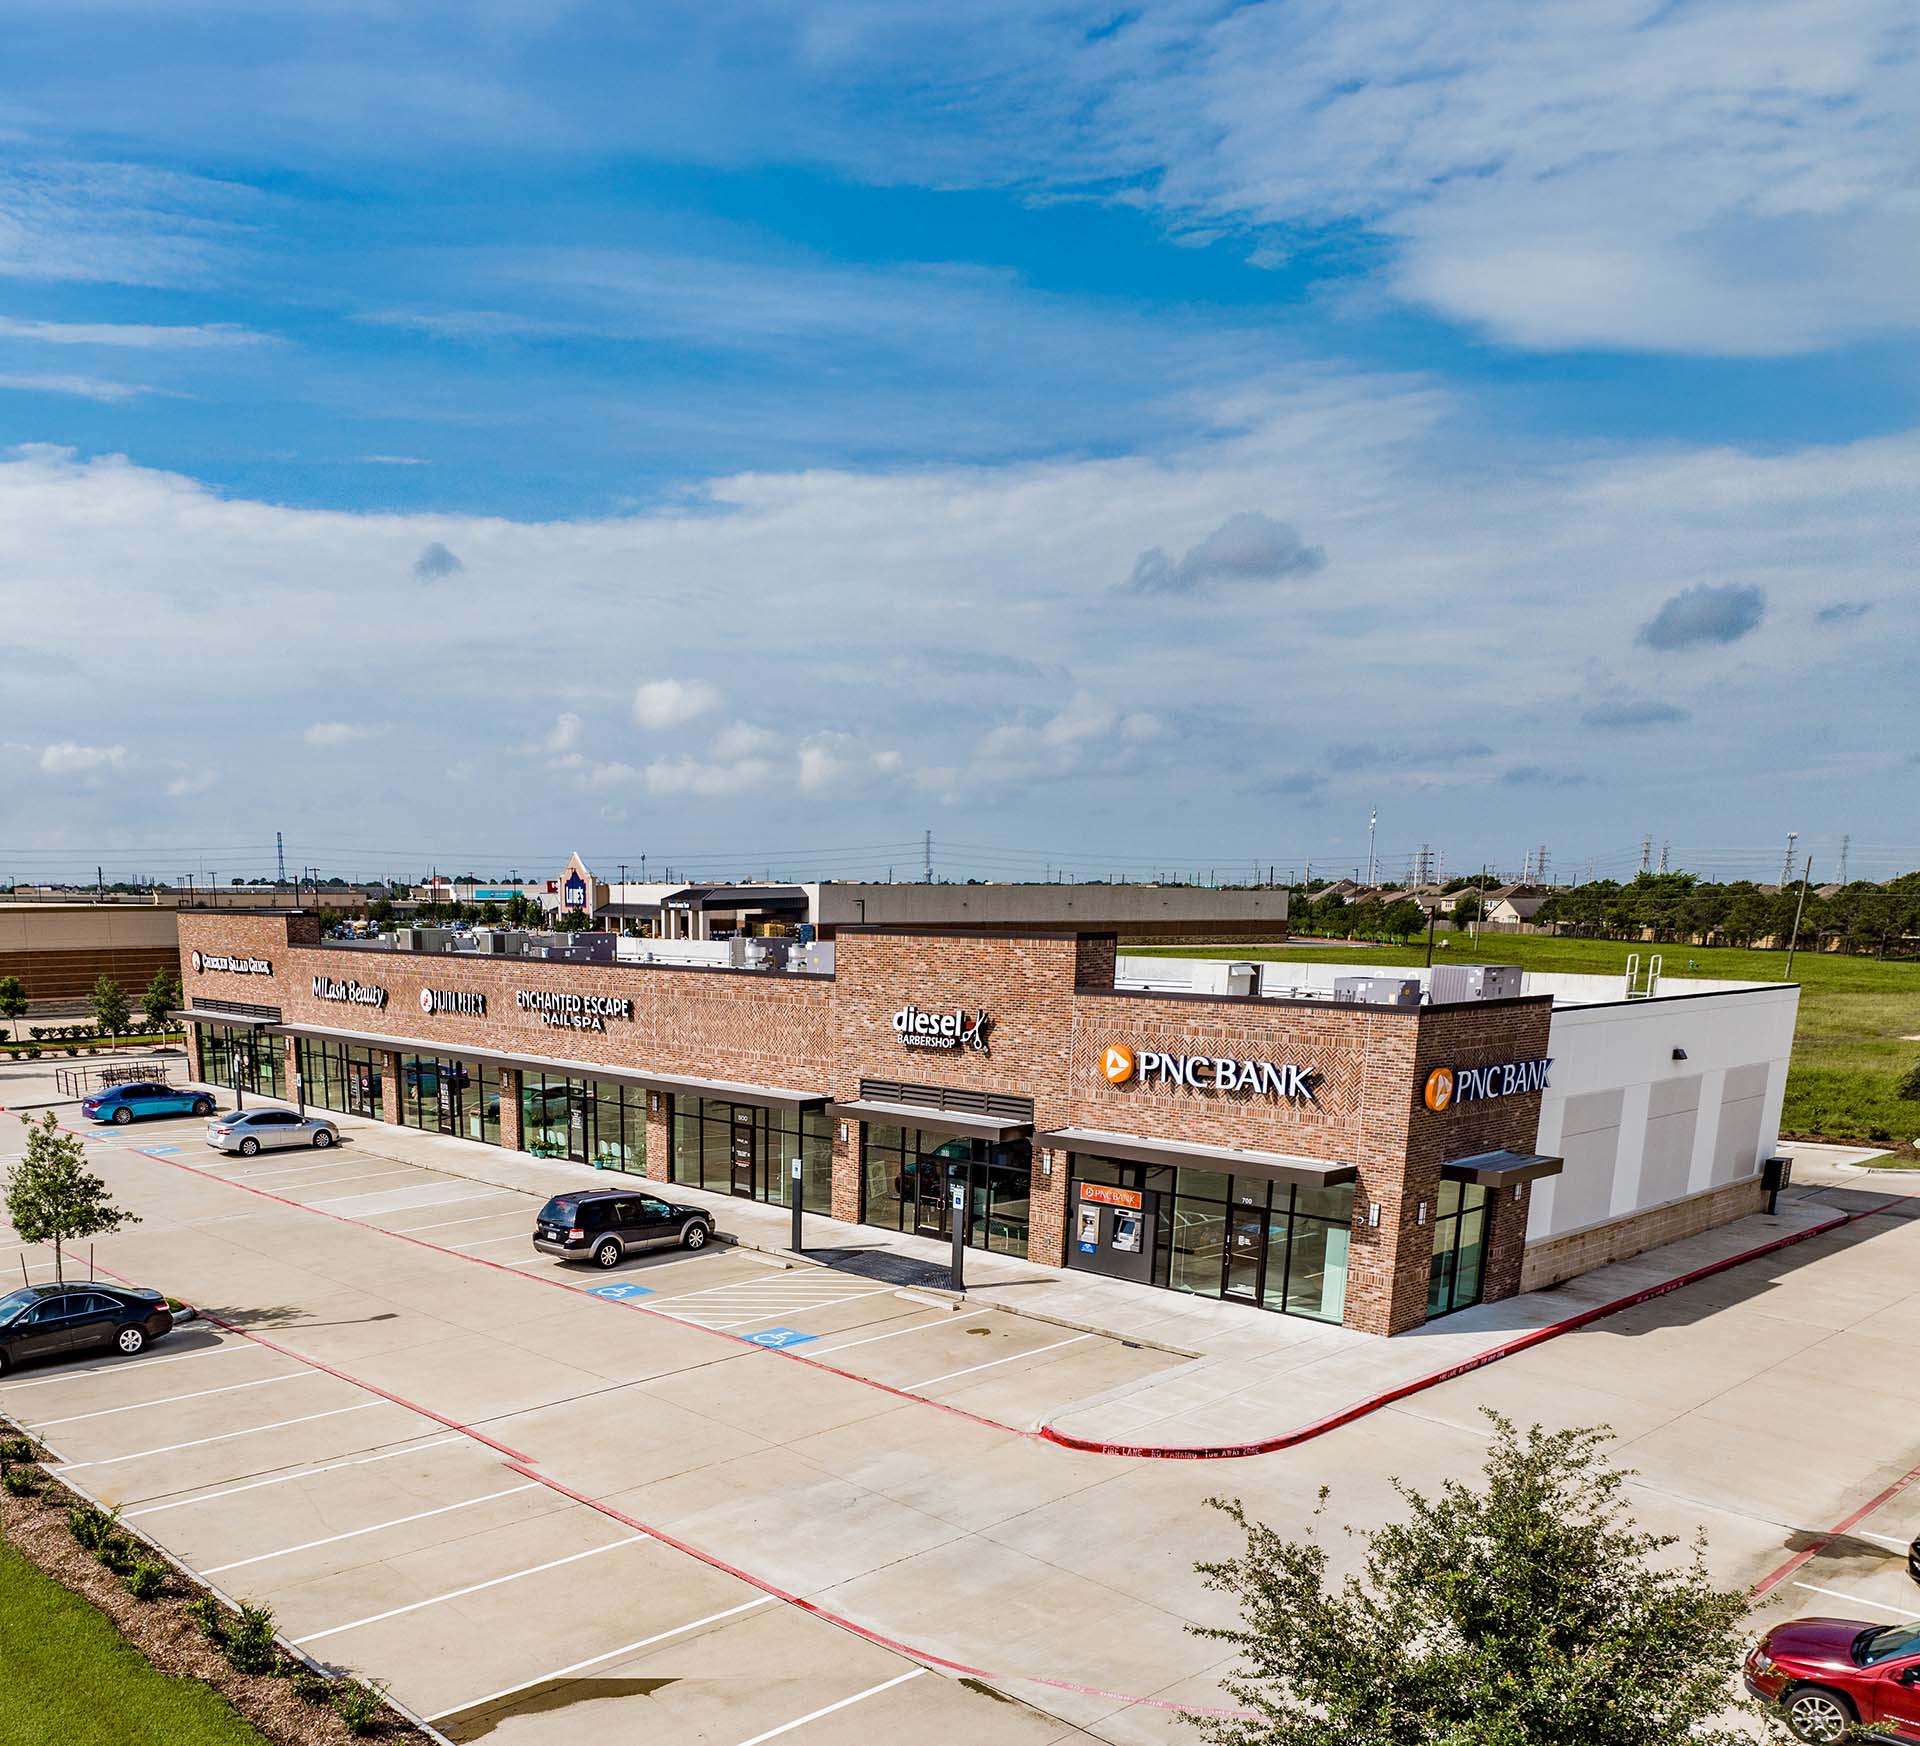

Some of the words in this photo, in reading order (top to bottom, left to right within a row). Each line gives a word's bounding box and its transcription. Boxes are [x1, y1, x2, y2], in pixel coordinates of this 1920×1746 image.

[202, 954, 228, 970] CHICKEN
[228, 956, 249, 972] SALAD
[249, 957, 270, 974] CHICK
[348, 980, 384, 1009] Beauty
[433, 990, 456, 1011] FAJITA
[458, 991, 483, 1014] PETE'S
[516, 990, 581, 1012] ENCHANTED
[584, 995, 629, 1017] ESCAPE
[541, 1012, 570, 1026] NAIL
[574, 1016, 602, 1029] SPA
[892, 1006, 962, 1036] diesel
[897, 1034, 956, 1048] BARBERSHOP
[1137, 1051, 1209, 1088] PNC
[1213, 1058, 1314, 1099] BANK
[1455, 1066, 1501, 1103] PNC
[1502, 1059, 1554, 1095] BANK
[1095, 1189, 1112, 1199] PNC
[1113, 1191, 1136, 1204] BANK
[1241, 1197, 1253, 1205] 700
[1102, 1445, 1120, 1455] FIRE
[1122, 1447, 1143, 1457] LANE
